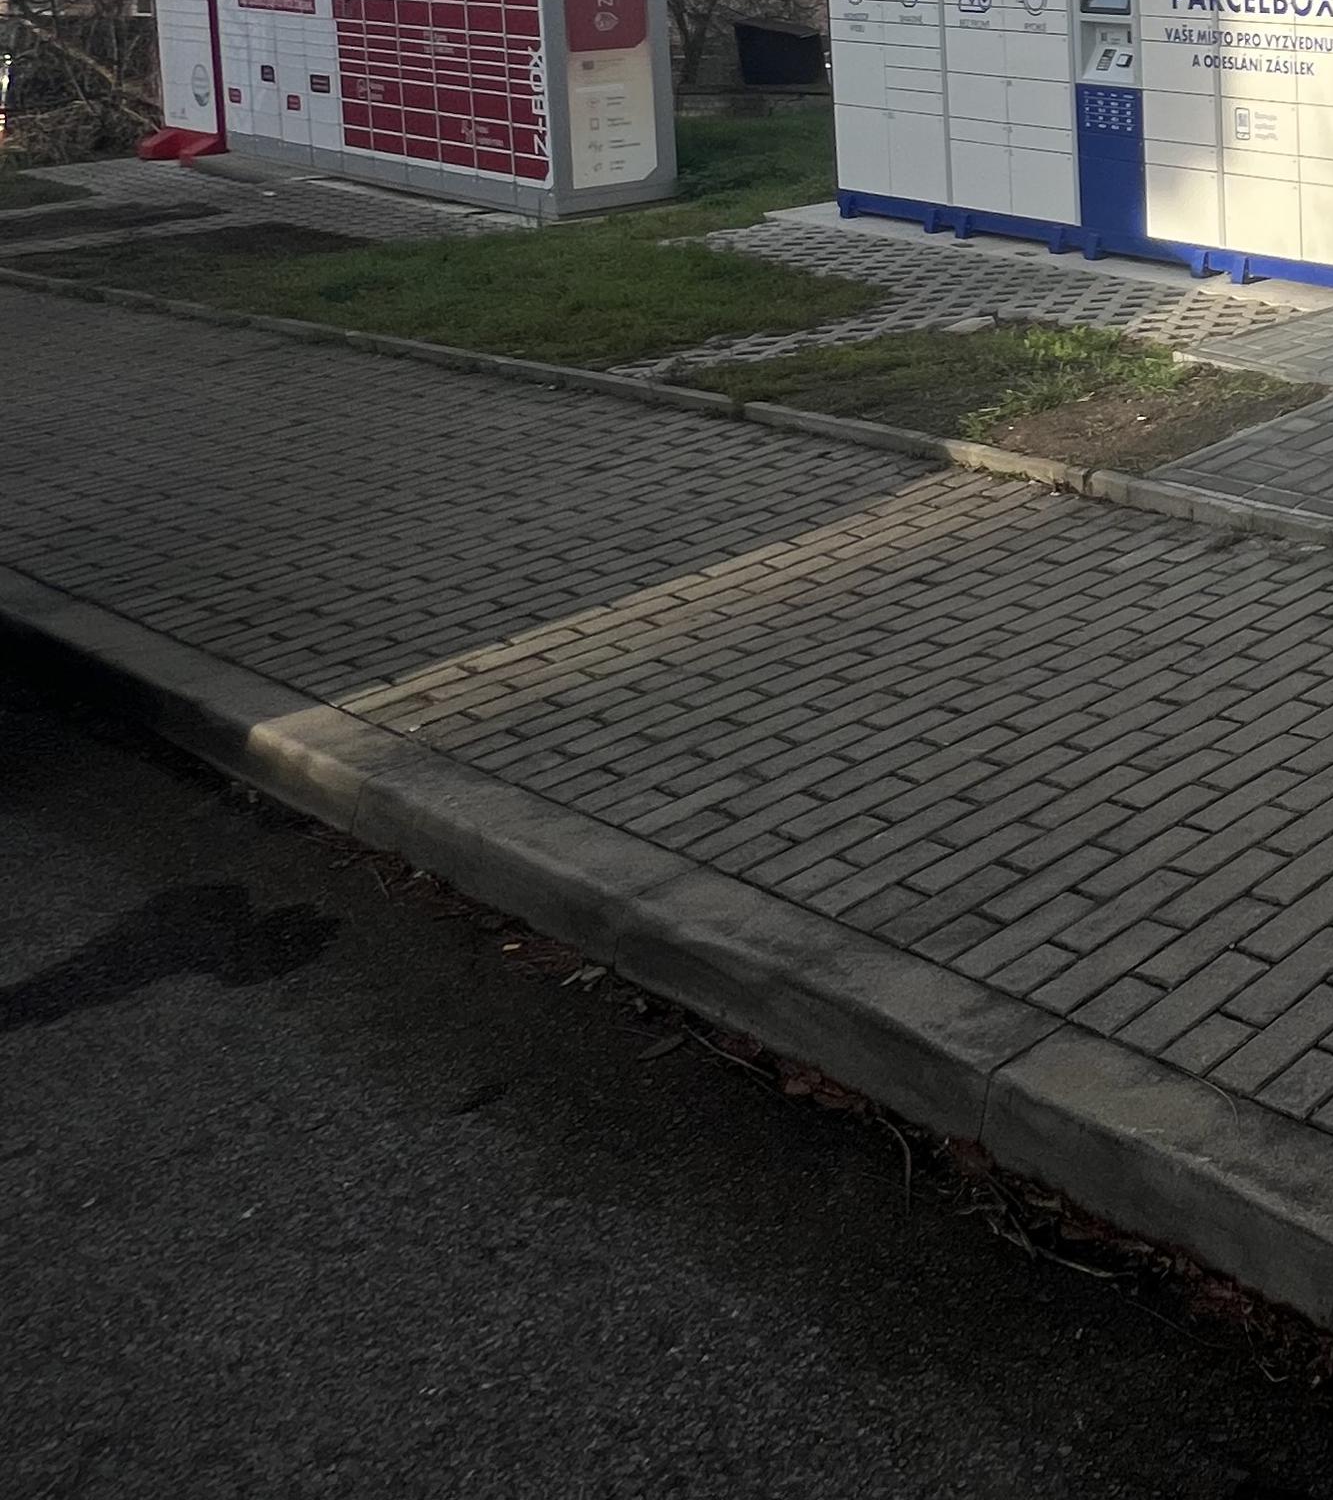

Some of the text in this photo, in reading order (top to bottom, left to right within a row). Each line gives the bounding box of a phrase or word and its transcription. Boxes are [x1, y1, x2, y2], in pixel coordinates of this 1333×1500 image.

[1165, 25, 1195, 43] VAŠE
[1197, 26, 1233, 46] MÍSTO
[1237, 33, 1261, 46] PRO
[1192, 53, 1315, 76] A ODESLÁNÍ ZÁSILEK
